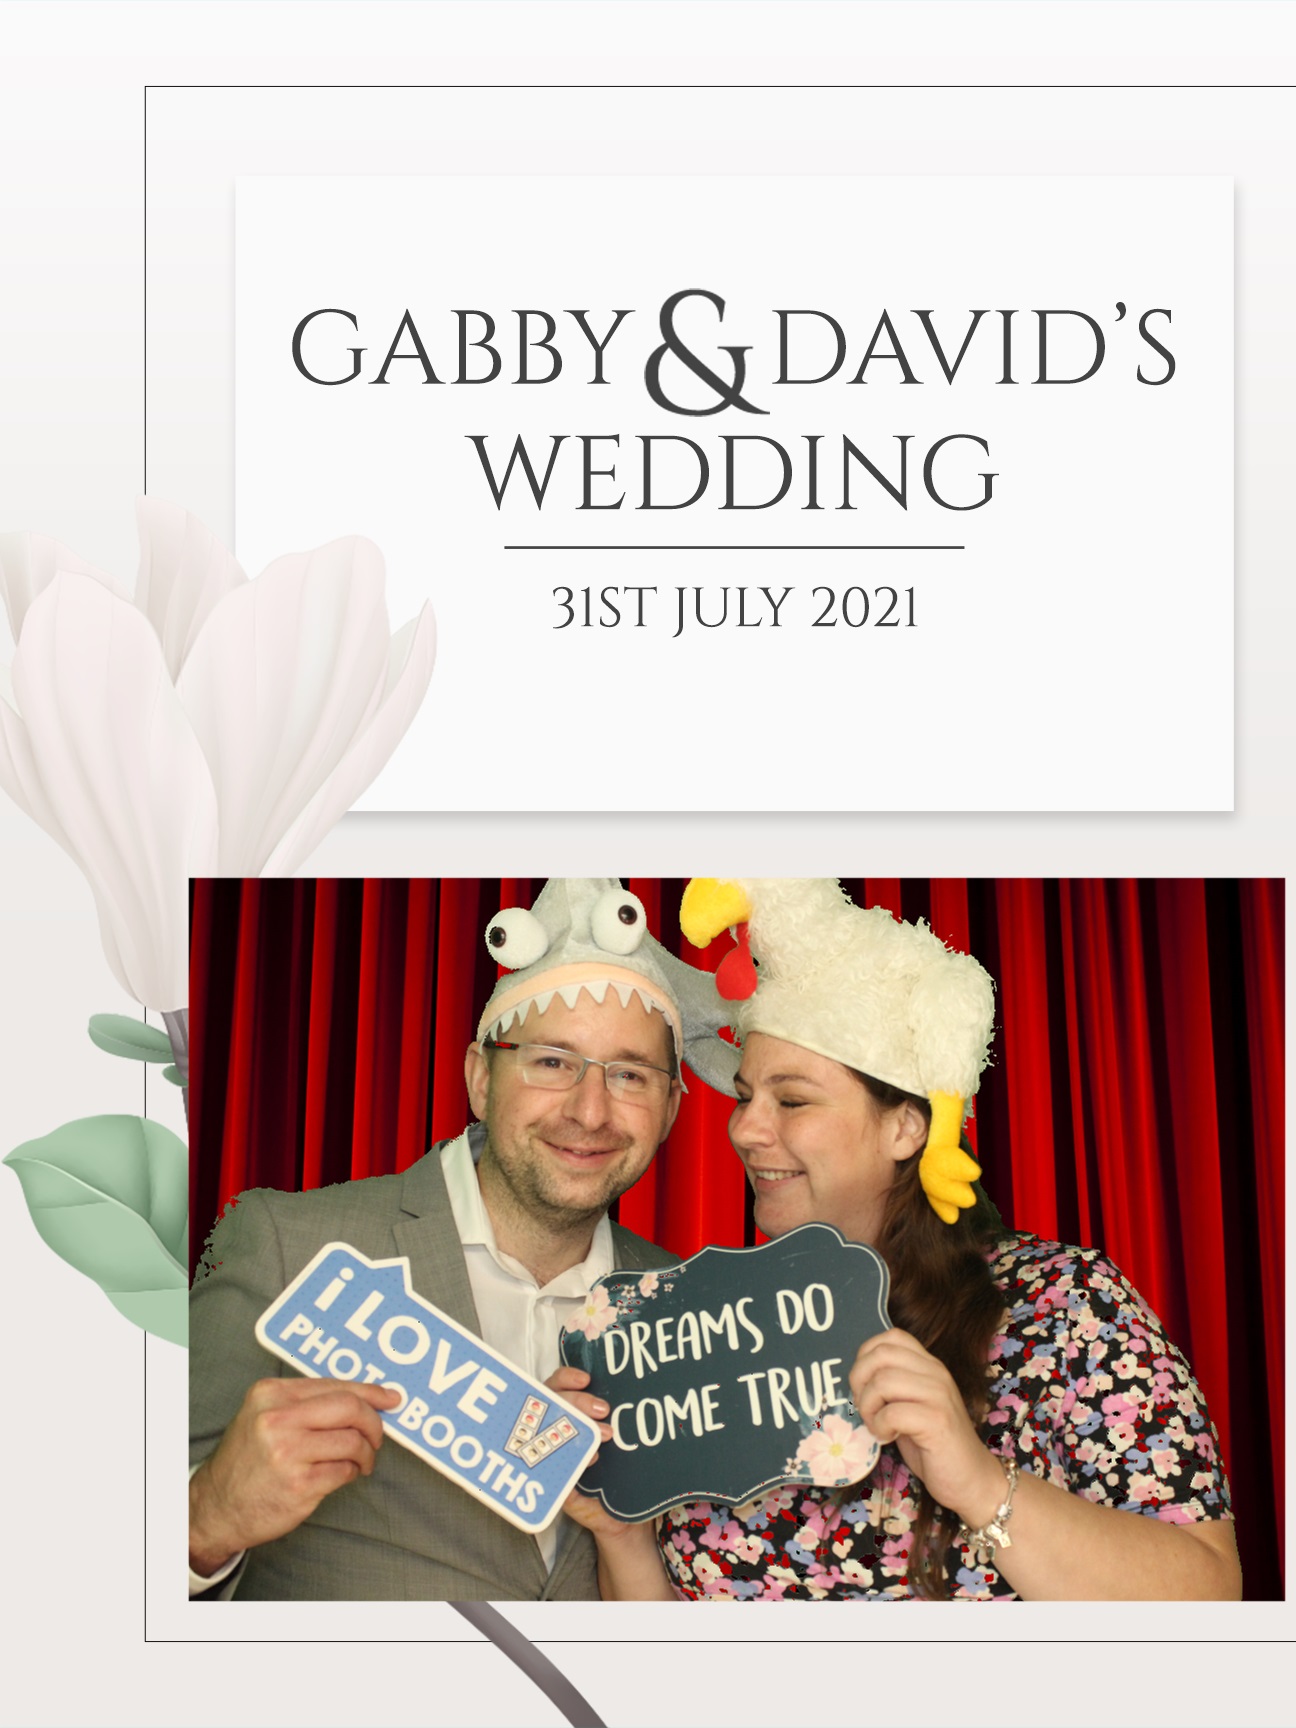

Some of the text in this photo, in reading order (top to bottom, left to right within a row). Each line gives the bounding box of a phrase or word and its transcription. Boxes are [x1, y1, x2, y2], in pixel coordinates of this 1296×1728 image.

[344, 1290, 508, 1424] LOVE
[604, 1283, 834, 1379] DREAMS DO
[611, 1358, 848, 1451] COME TRUE
